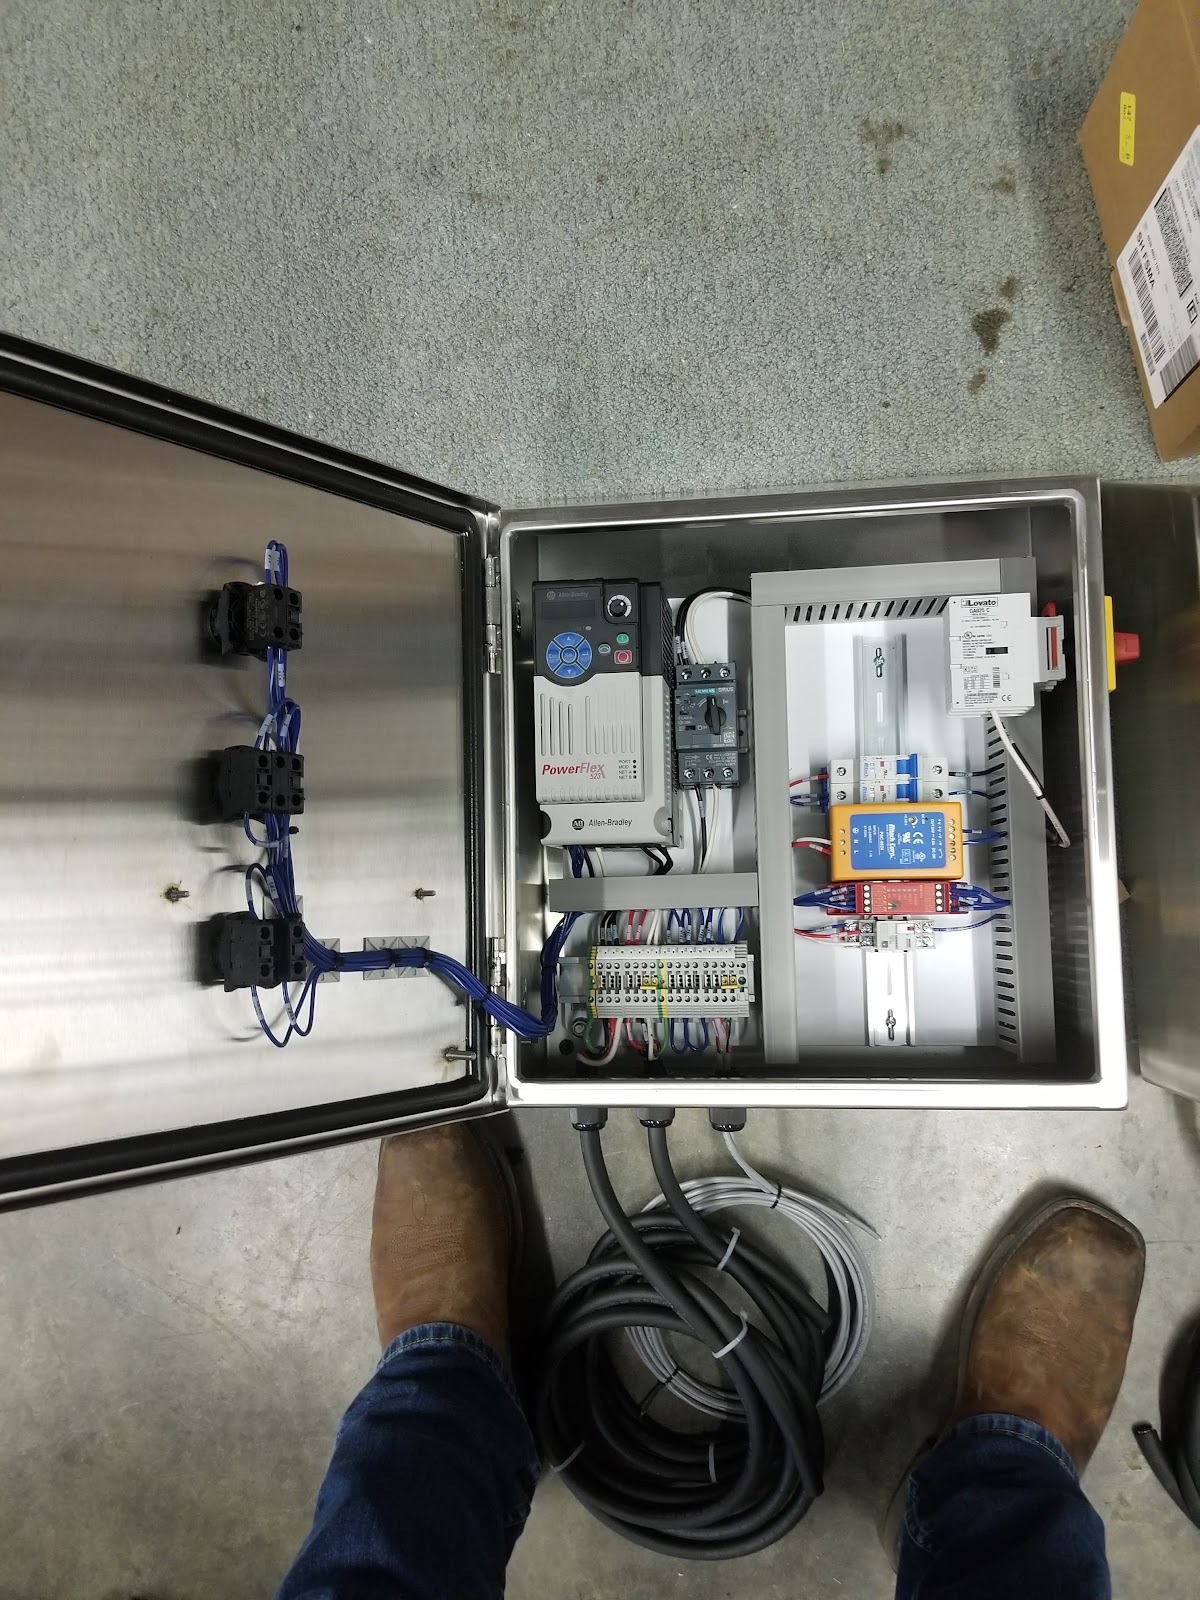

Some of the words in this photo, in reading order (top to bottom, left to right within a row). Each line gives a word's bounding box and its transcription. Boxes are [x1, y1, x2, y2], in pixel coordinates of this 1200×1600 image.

[969, 599, 997, 607] Lovato
[542, 762, 606, 779] PowerFlex
[588, 818, 632, 828] Allen-Bradley
